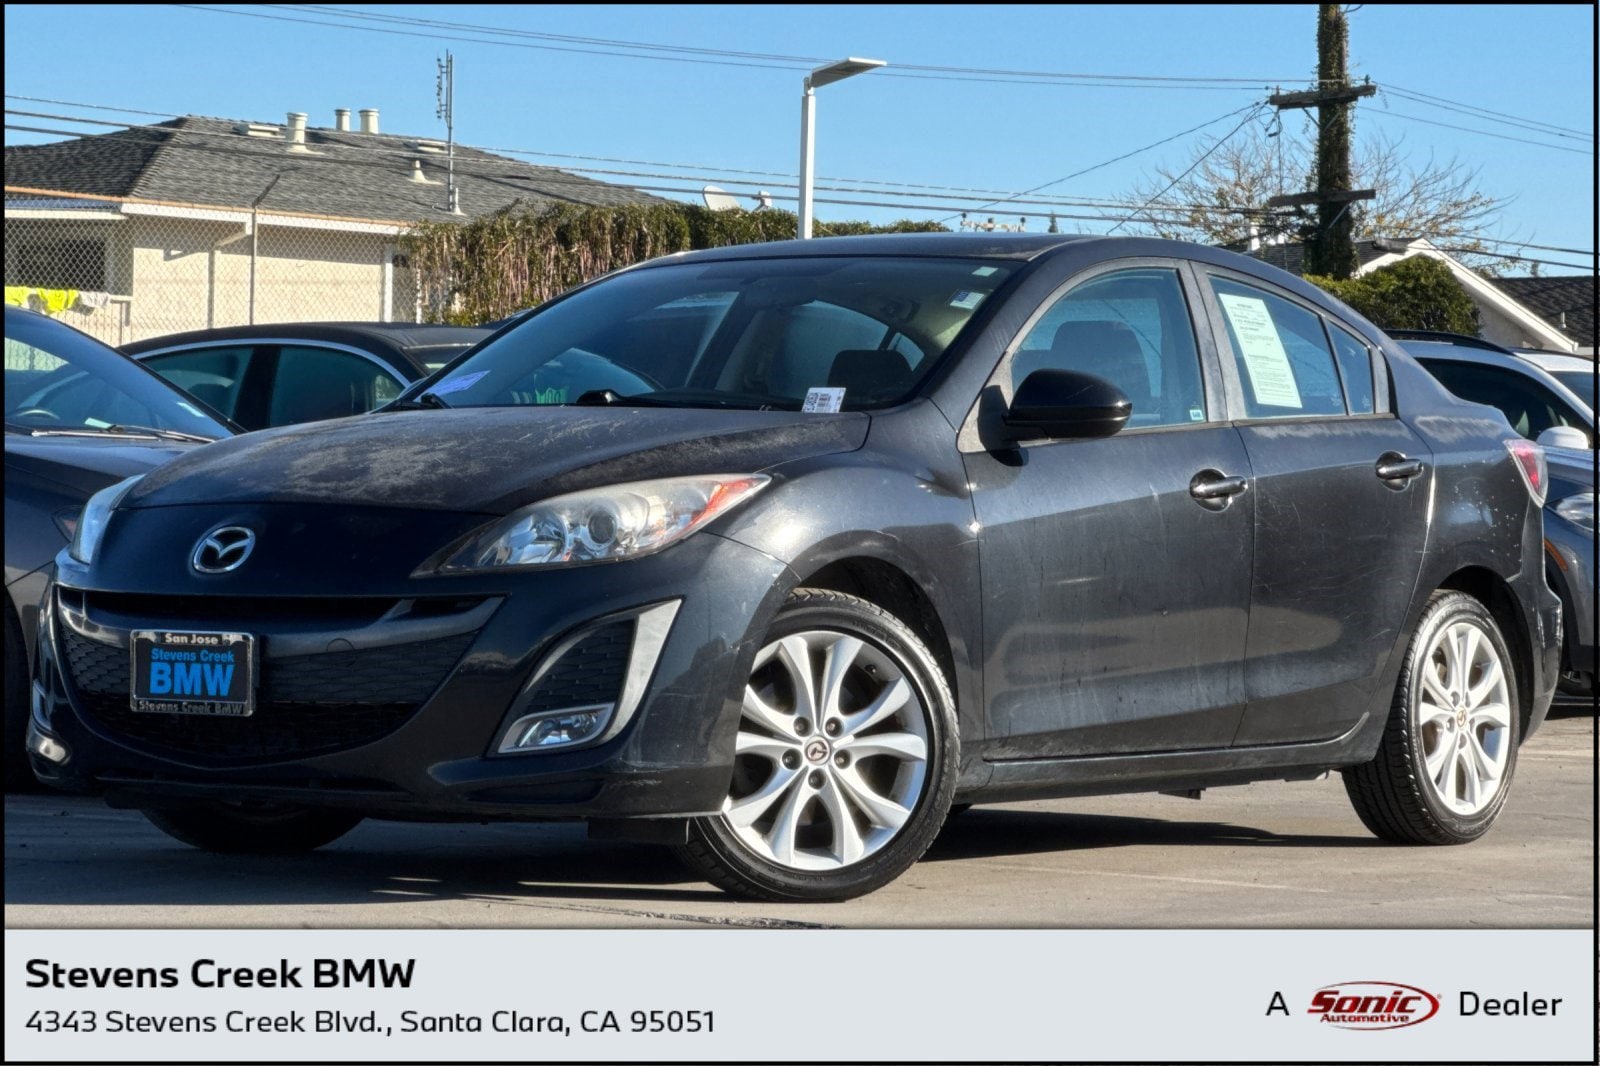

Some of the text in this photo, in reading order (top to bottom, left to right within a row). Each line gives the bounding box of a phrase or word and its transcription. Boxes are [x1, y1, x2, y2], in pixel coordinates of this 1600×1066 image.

[165, 633, 218, 644] San Jose
[151, 648, 234, 662] Stevens Creek
[149, 662, 235, 696] BMW
[139, 701, 179, 712] Stevens
[181, 702, 211, 713] Creek
